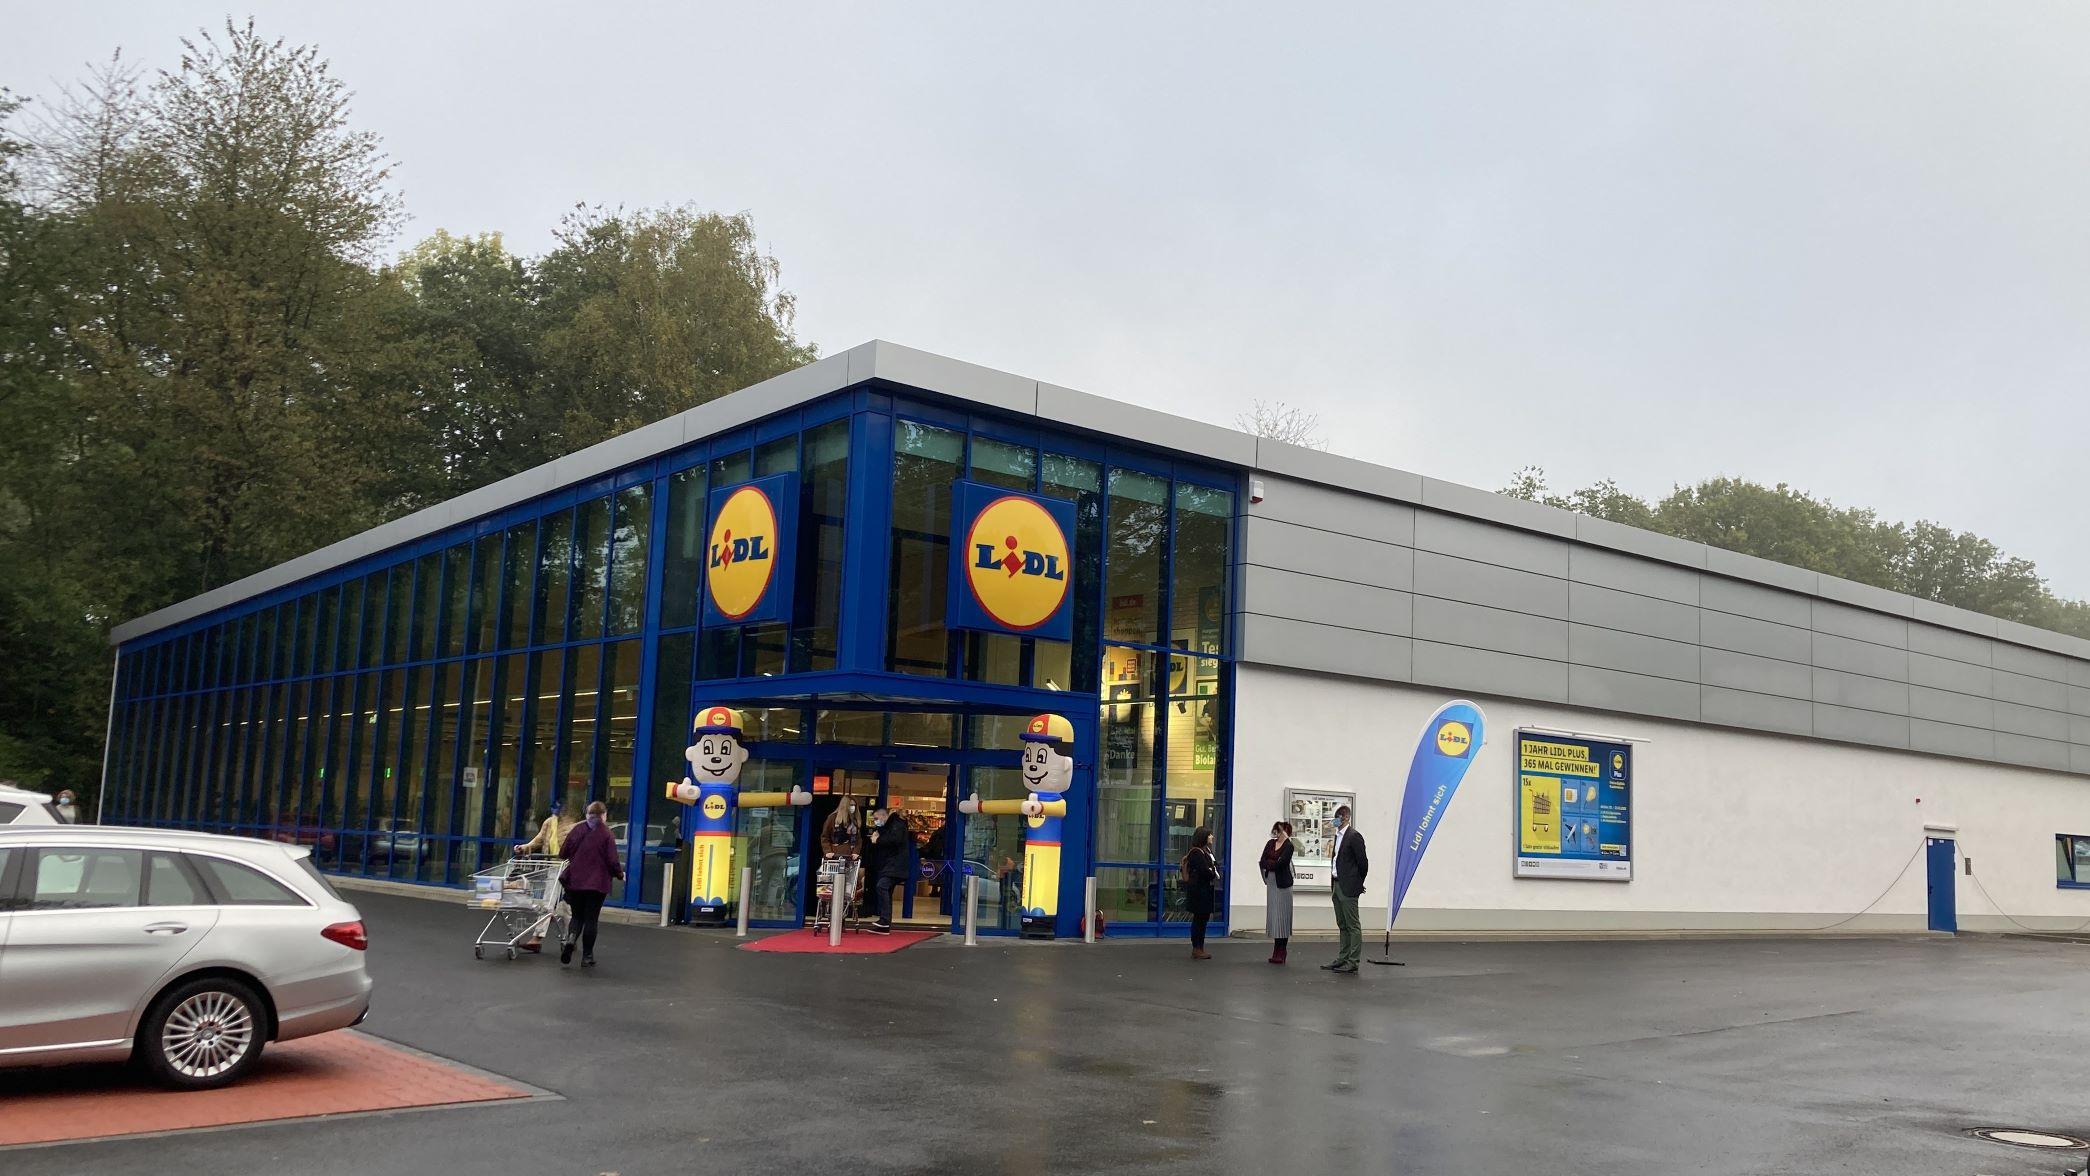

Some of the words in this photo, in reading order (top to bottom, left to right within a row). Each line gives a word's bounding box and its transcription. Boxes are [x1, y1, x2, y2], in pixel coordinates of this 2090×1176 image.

[710, 529, 769, 571] LIDL
[975, 535, 1064, 580] LIDL
[1440, 731, 1468, 744] LIDL
[1109, 748, 1136, 760] Danke
[1523, 744, 1528, 753] 1
[1528, 744, 1549, 756] JAHR
[1549, 746, 1567, 757] LIDL
[1523, 758, 1537, 769] 365
[1537, 760, 1554, 770] MAL
[704, 801, 726, 810] LIDL
[1410, 832, 1424, 852] Lidl
[1419, 805, 1436, 832] lohnt
[1433, 784, 1448, 806] sich
